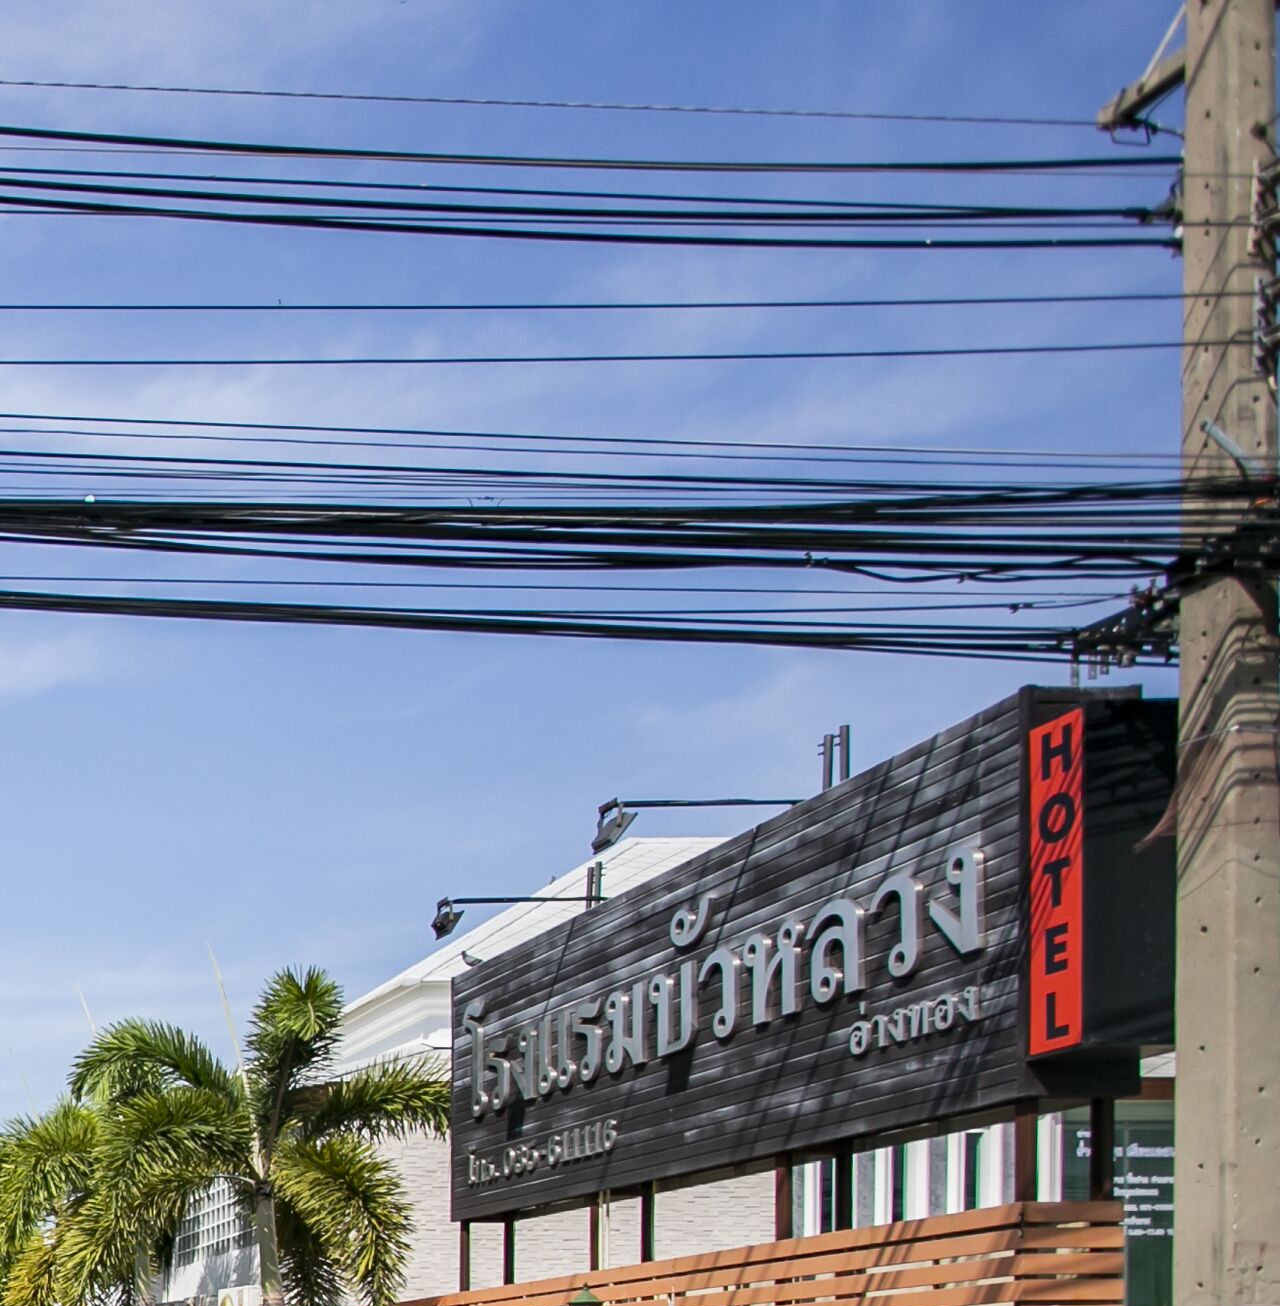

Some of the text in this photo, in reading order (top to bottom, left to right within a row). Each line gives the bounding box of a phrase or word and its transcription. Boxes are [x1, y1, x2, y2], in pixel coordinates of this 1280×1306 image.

[1039, 723, 1074, 1041] HOTEL
[849, 985, 979, 1056] อ่างทอง
